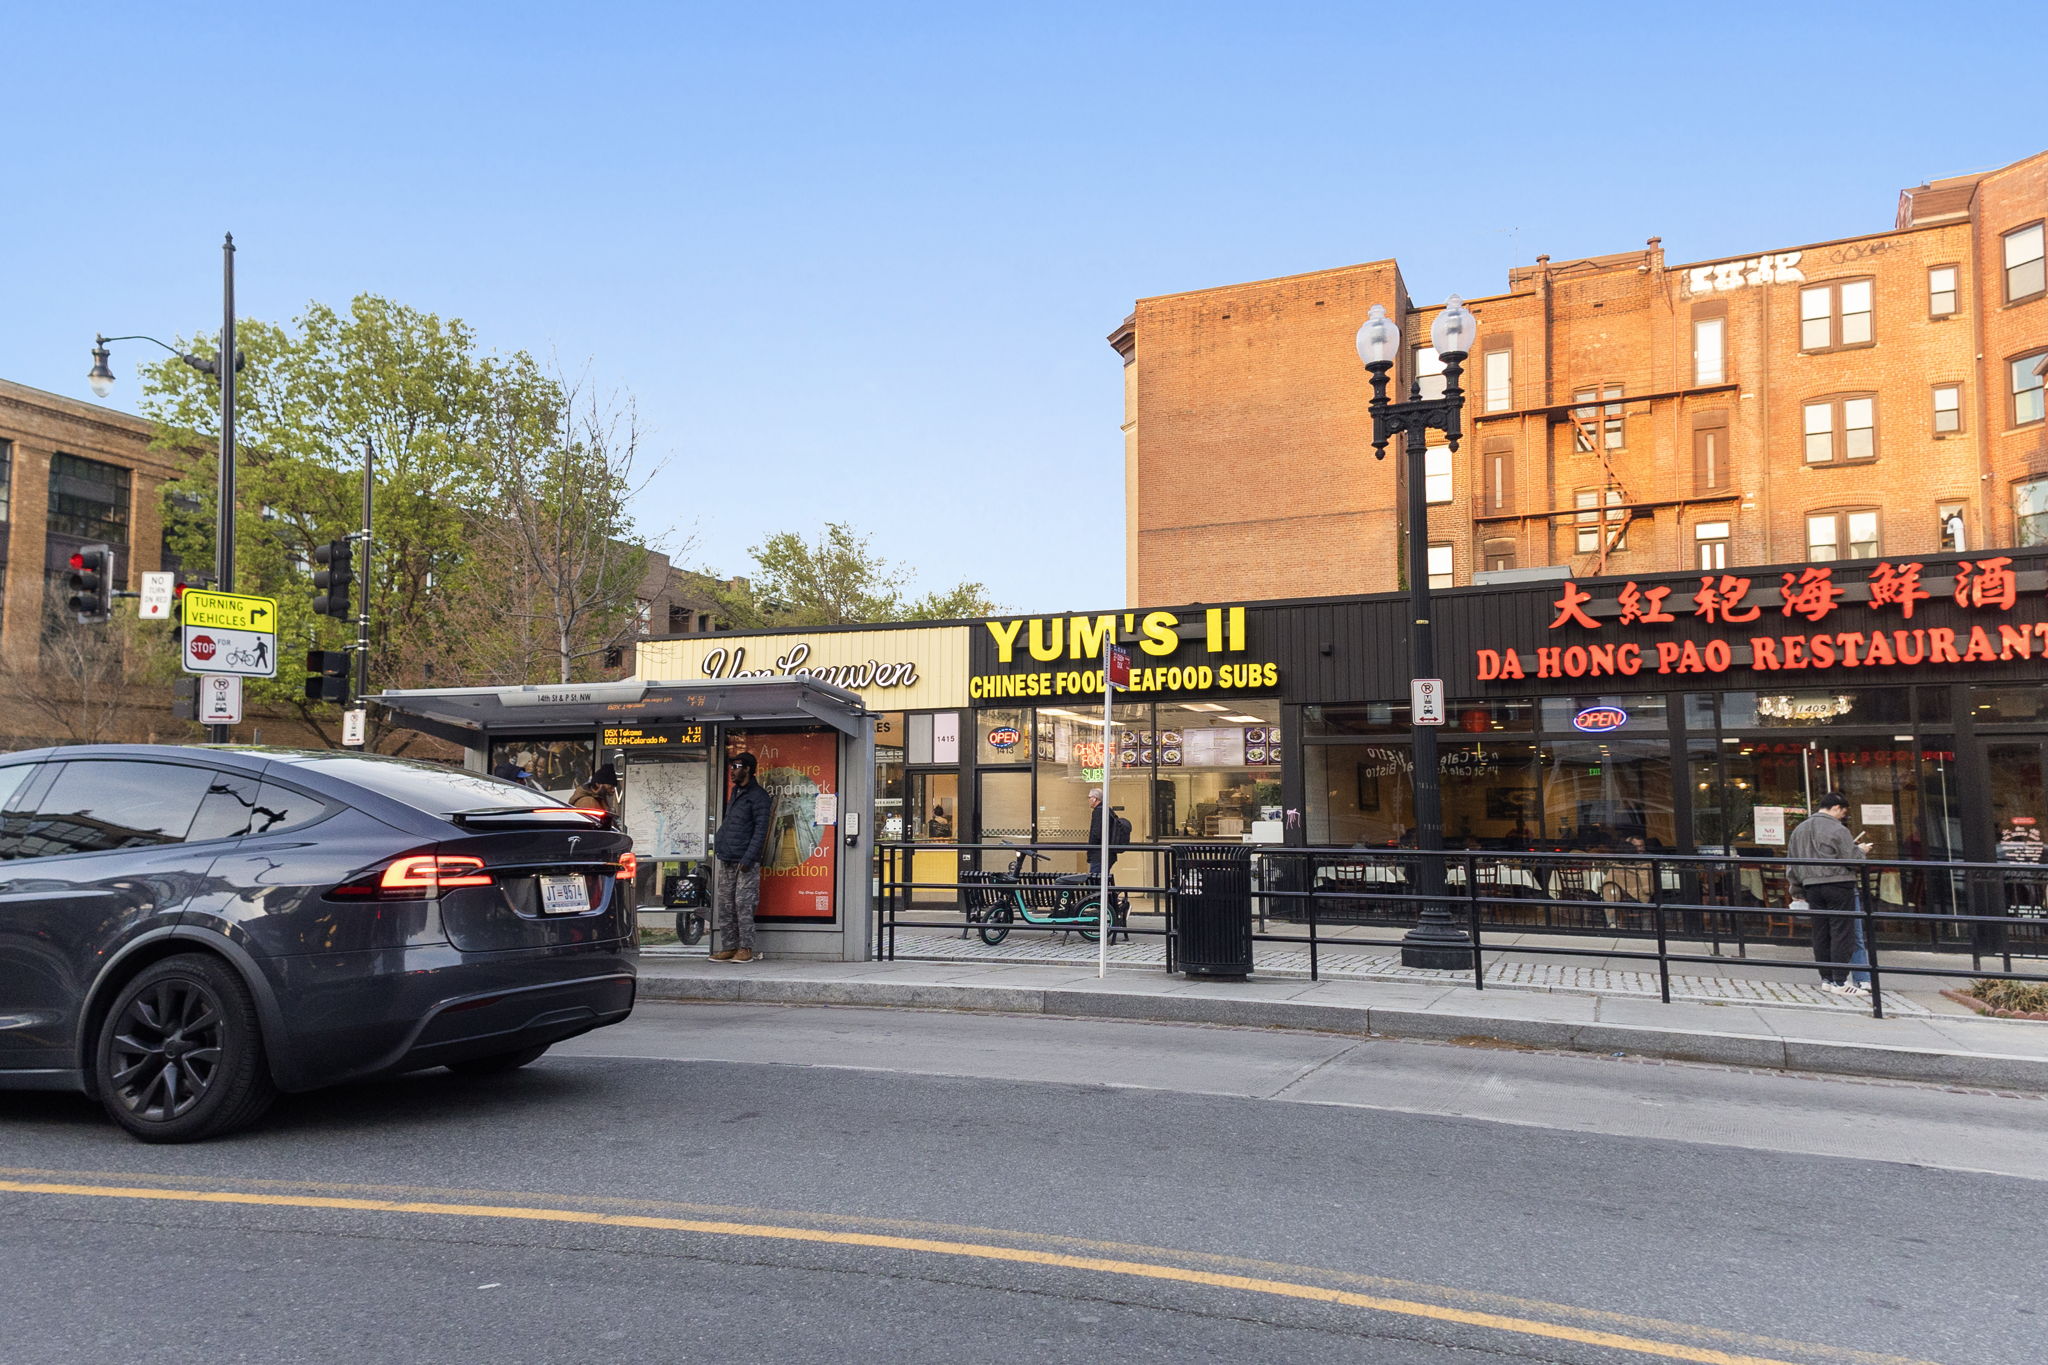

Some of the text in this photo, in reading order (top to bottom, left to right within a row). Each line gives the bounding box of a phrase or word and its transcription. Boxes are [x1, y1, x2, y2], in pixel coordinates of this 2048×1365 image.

[151, 576, 164, 584] NO
[195, 596, 244, 612] TURNING
[191, 612, 246, 627] VEHICLES
[985, 611, 1179, 663] YUM'S
[1206, 606, 1246, 653] II
[190, 638, 231, 654] STOP FOR
[1476, 648, 1525, 680] DA
[1537, 643, 1643, 678] HONG
[1656, 639, 1732, 674] PAO
[970, 672, 1053, 699] CHINESE
[1115, 665, 1213, 693] EAFOOD
[1219, 662, 1278, 689] SUBS
[552, 694, 558, 702] St
[559, 694, 564, 702] &
[565, 694, 570, 702] P
[580, 693, 591, 701] NW
[1799, 704, 1827, 713] 1409
[1578, 711, 1622, 727] OPEN
[619, 729, 643, 737] Takoma
[874, 722, 891, 733] ES
[989, 732, 1019, 745] OPEN
[760, 744, 779, 759] An
[1074, 743, 1115, 757] CHINEE
[1082, 755, 1105, 767] FOO
[763, 780, 831, 797] landmark
[808, 842, 829, 858] for
[760, 863, 828, 880] ploration
[546, 886, 556, 901] JT
[1058, 890, 1070, 911] veo
